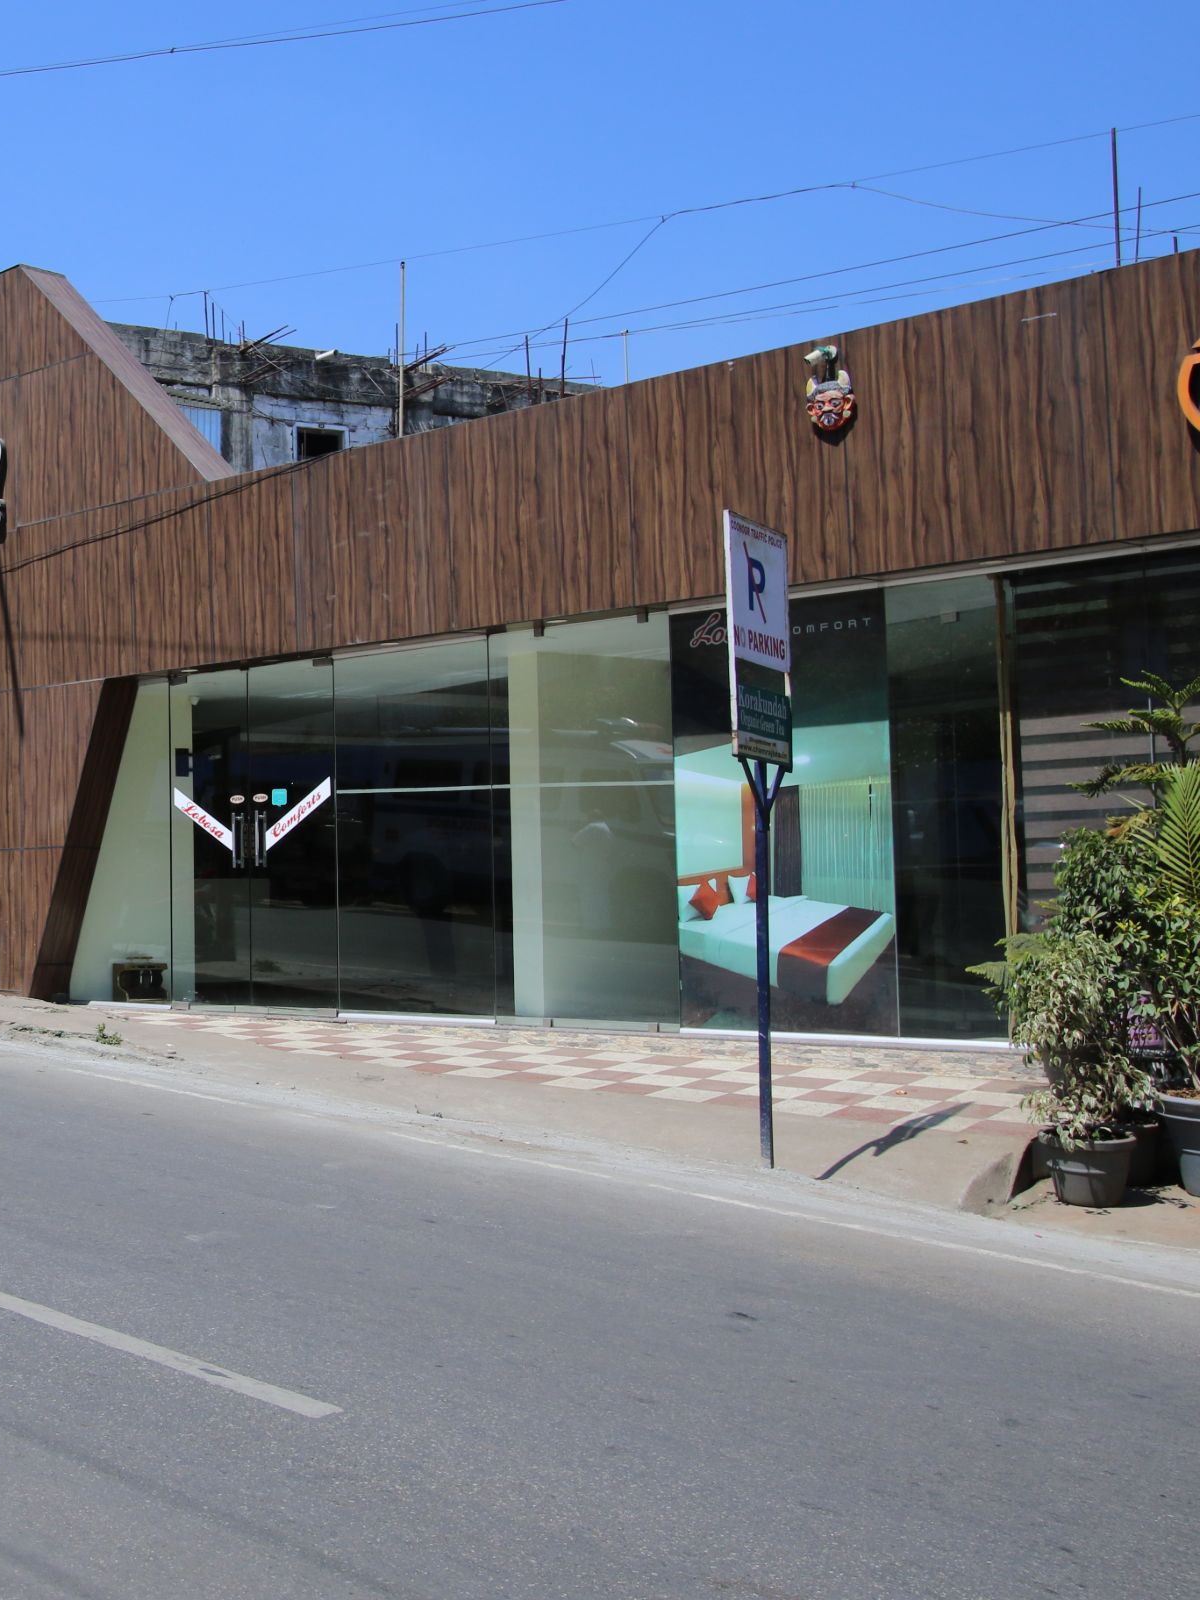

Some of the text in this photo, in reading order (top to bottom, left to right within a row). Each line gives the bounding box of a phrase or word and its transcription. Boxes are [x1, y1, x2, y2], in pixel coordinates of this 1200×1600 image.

[750, 528, 768, 543] TRAFFIC
[768, 535, 783, 549] POLICE
[733, 624, 746, 648] NO
[748, 629, 785, 660] PARKING
[792, 617, 871, 635] OMFORT
[738, 685, 787, 719] Korakundah
[740, 710, 785, 736] Organic Green Tea
[181, 801, 224, 839] Lobosa
[272, 791, 322, 838] Comforts
